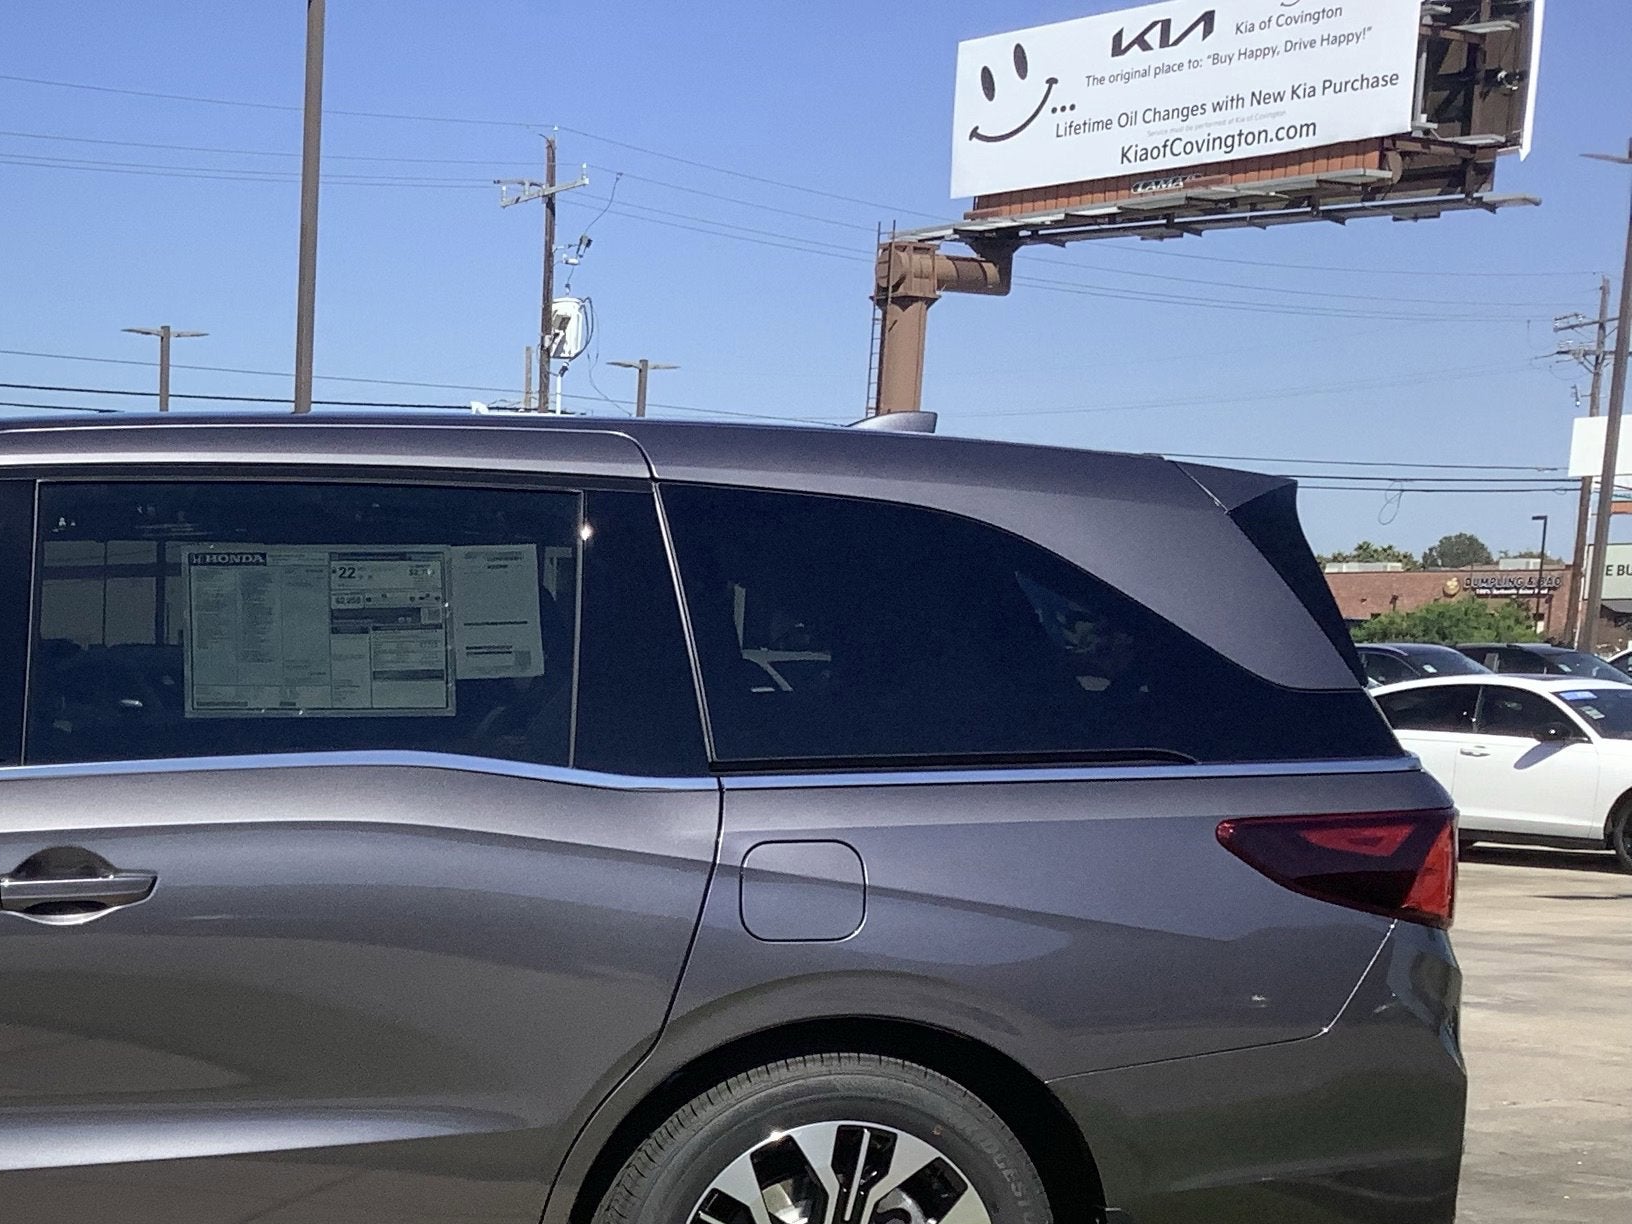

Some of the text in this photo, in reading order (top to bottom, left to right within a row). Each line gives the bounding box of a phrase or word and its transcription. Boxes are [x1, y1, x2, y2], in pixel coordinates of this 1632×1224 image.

[1111, 9, 1216, 58] KIA
[1235, 6, 1343, 35] Kia of Covington
[1085, 74, 1106, 88] The
[1108, 65, 1151, 85] original
[1153, 60, 1184, 79] place
[1187, 57, 1204, 71] to:
[1237, 44, 1280, 62] Happy,
[1284, 37, 1317, 54] Drive
[1055, 72, 1400, 139] Lifetime Oil Changes with New Kia Purchase
[1120, 121, 1317, 165] KiaofCovington.com
[206, 553, 265, 564] HONDA
[338, 566, 356, 580] 22
[1464, 577, 1524, 588] DUMPLING
[1527, 576, 1535, 587] &
